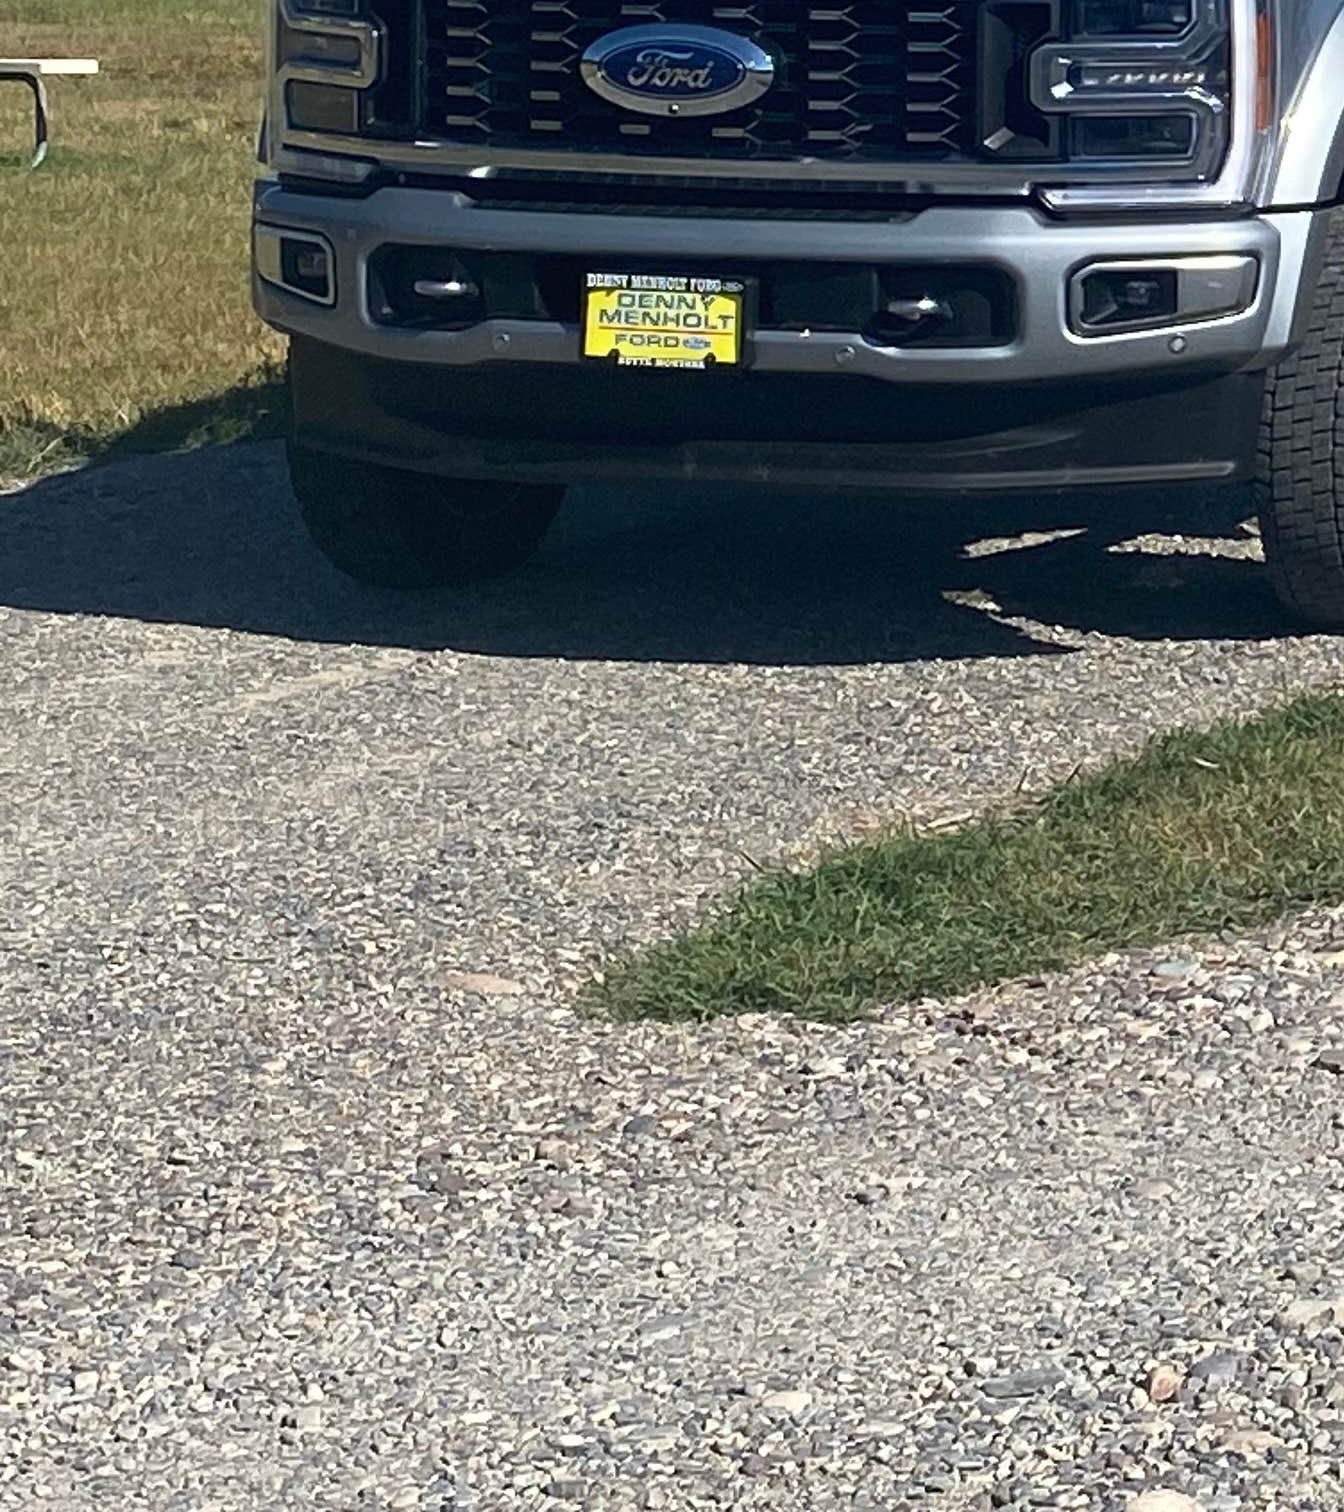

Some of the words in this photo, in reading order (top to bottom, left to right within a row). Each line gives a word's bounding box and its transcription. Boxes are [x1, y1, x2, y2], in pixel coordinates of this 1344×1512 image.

[627, 48, 715, 88] Ford
[617, 293, 715, 311] DENNY
[599, 309, 734, 330] MENHOLT
[614, 333, 679, 348] FORD
